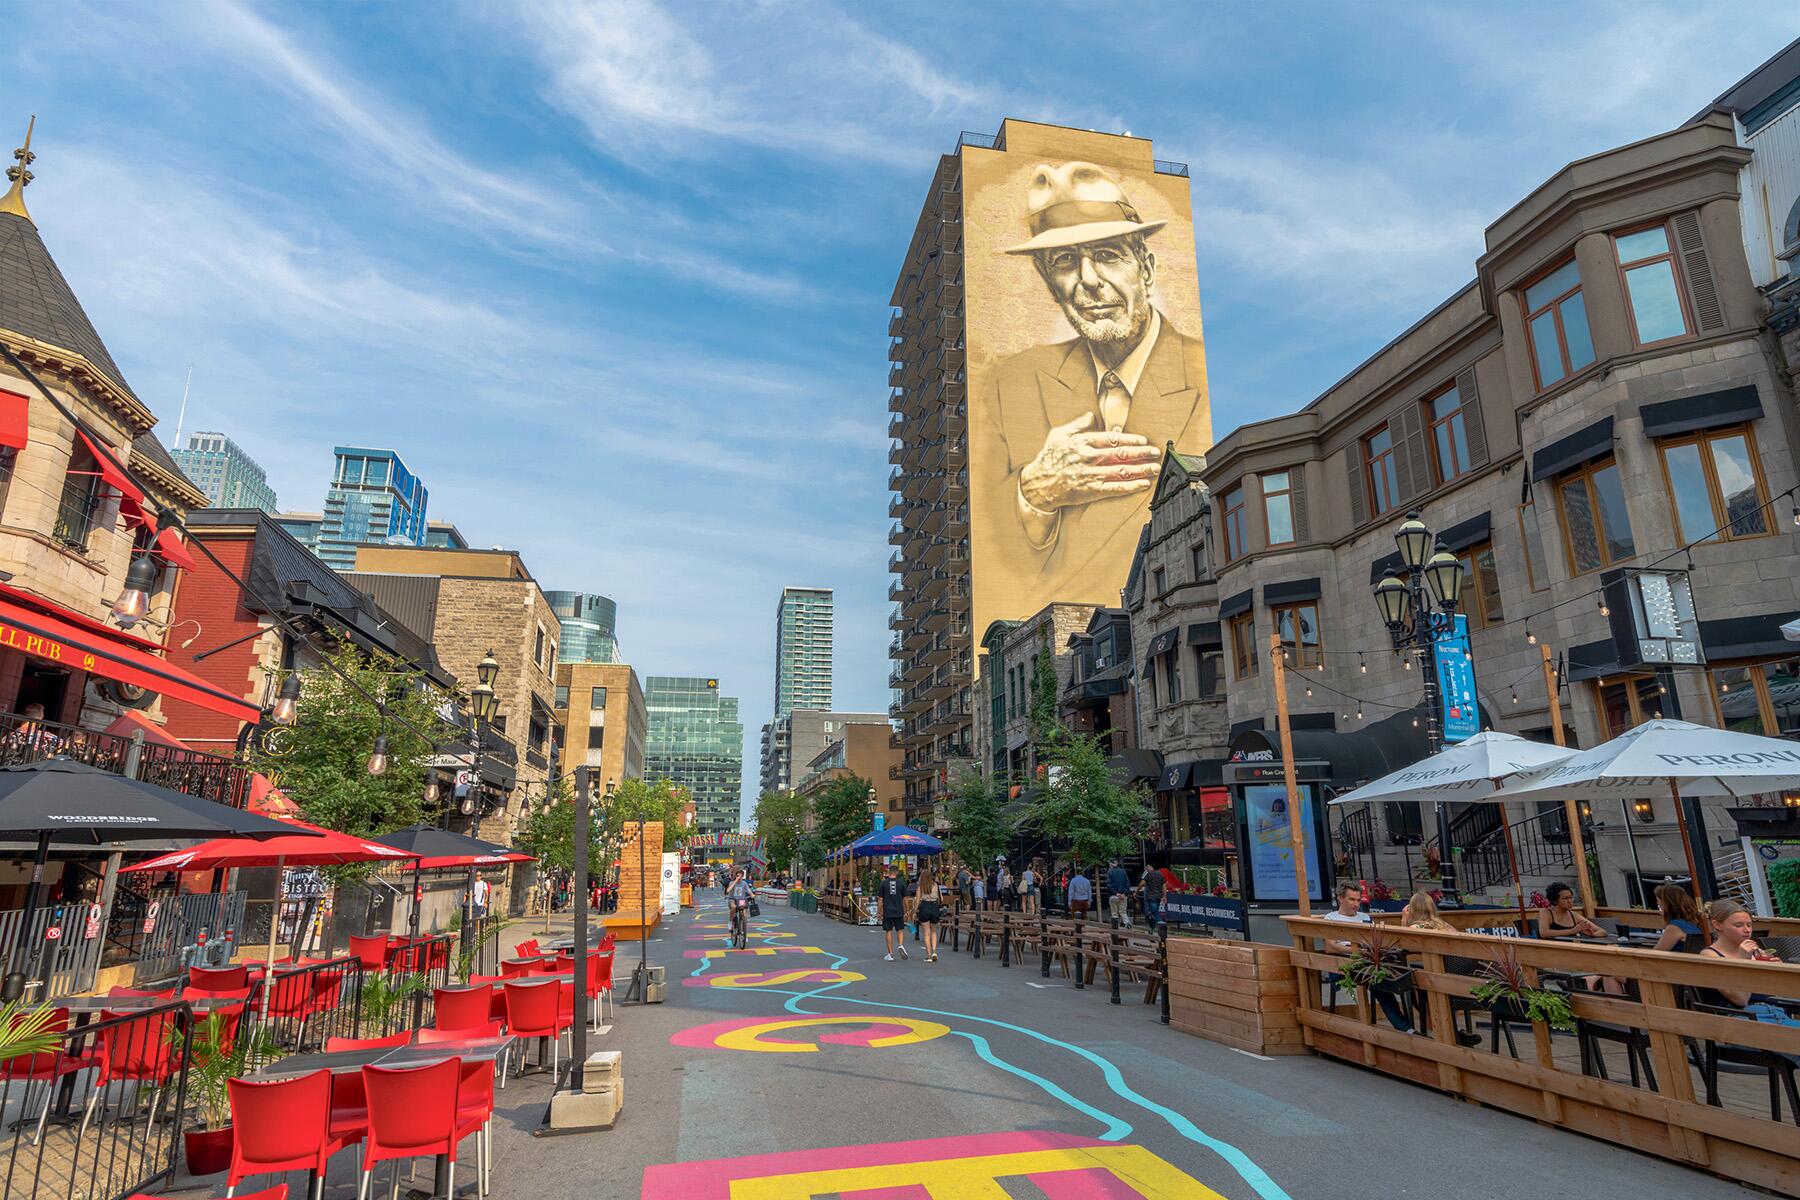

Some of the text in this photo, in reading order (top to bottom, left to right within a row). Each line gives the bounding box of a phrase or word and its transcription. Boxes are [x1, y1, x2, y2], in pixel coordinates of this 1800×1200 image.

[26, 634, 61, 660] PUB
[1656, 750, 1800, 766] PERONI
[1392, 762, 1472, 785] PERONI
